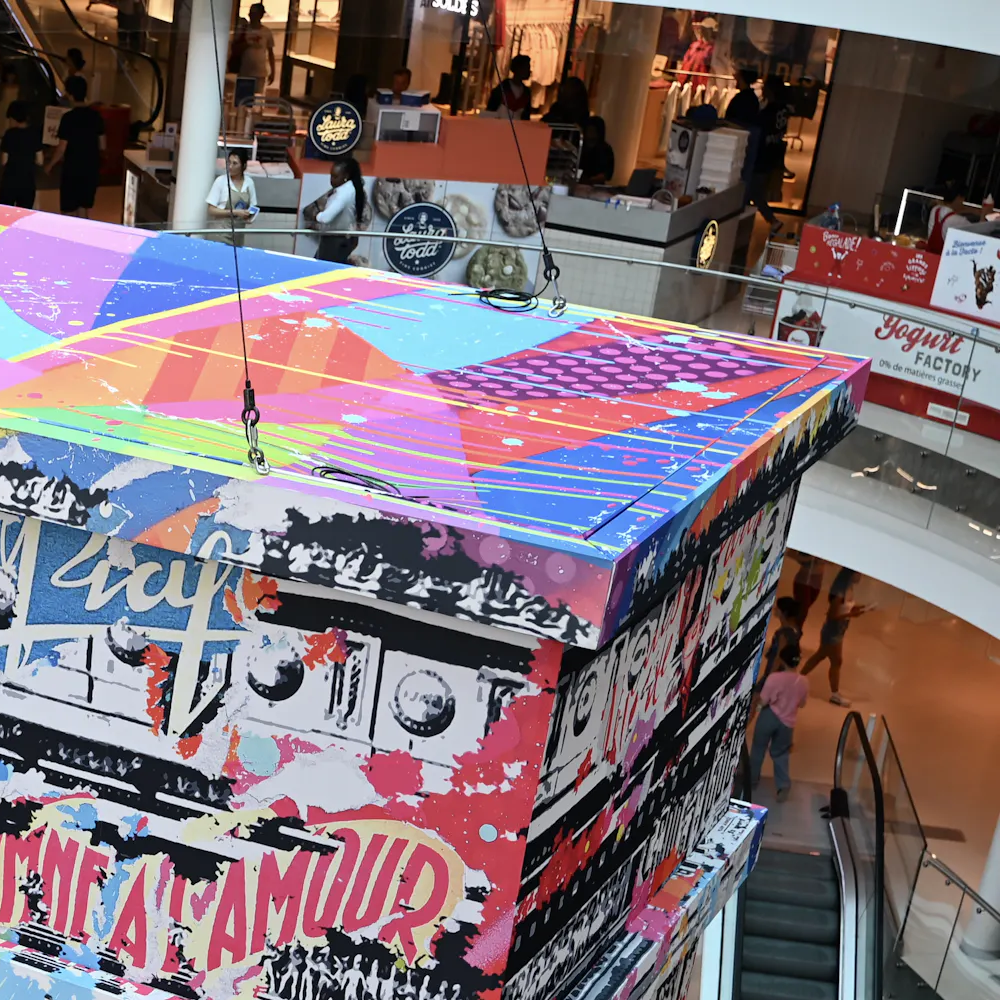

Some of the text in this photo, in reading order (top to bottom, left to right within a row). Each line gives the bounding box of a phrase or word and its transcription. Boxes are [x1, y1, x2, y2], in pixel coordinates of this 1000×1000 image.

[874, 313, 965, 355] Yogurt
[879, 359, 963, 391] 0% de matières grasse
[914, 351, 981, 383] FACTORY
